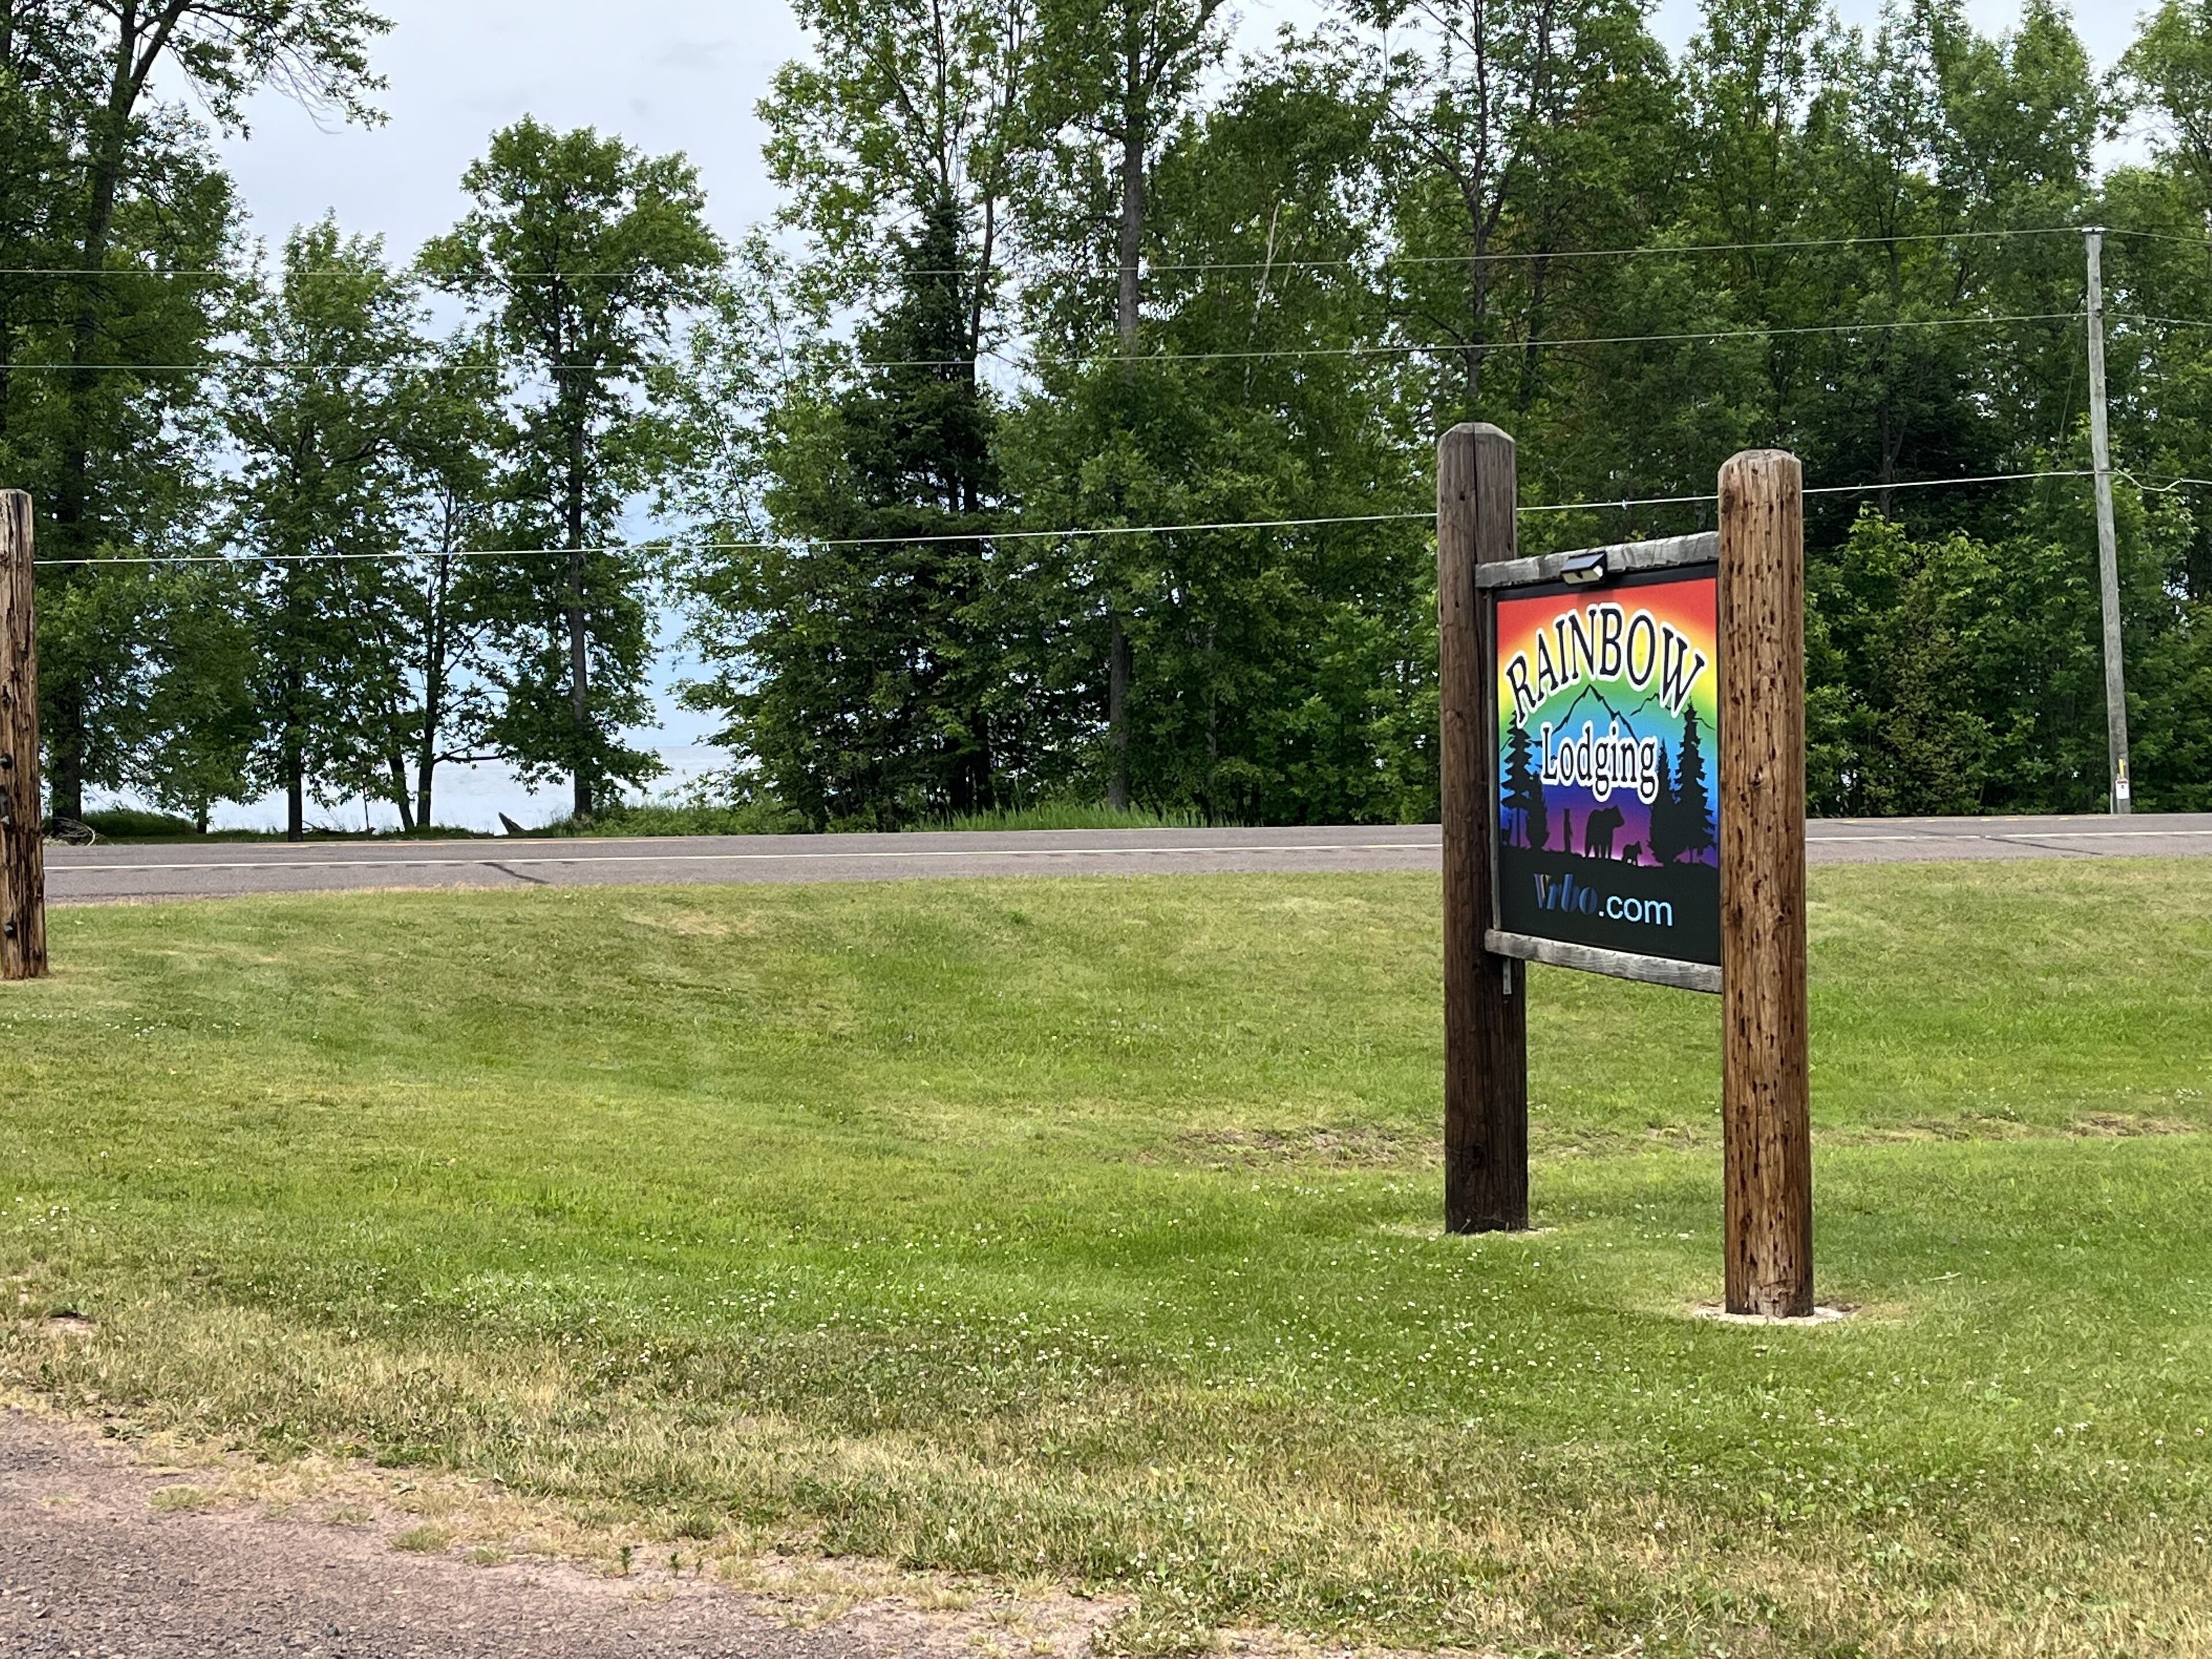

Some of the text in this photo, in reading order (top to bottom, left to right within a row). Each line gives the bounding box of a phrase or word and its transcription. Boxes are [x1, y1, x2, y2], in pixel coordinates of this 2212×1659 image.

[1505, 607, 1706, 725] RAINBOW
[1542, 724, 1657, 800] Lodging
[1533, 873, 1673, 926] Vrbo.com
